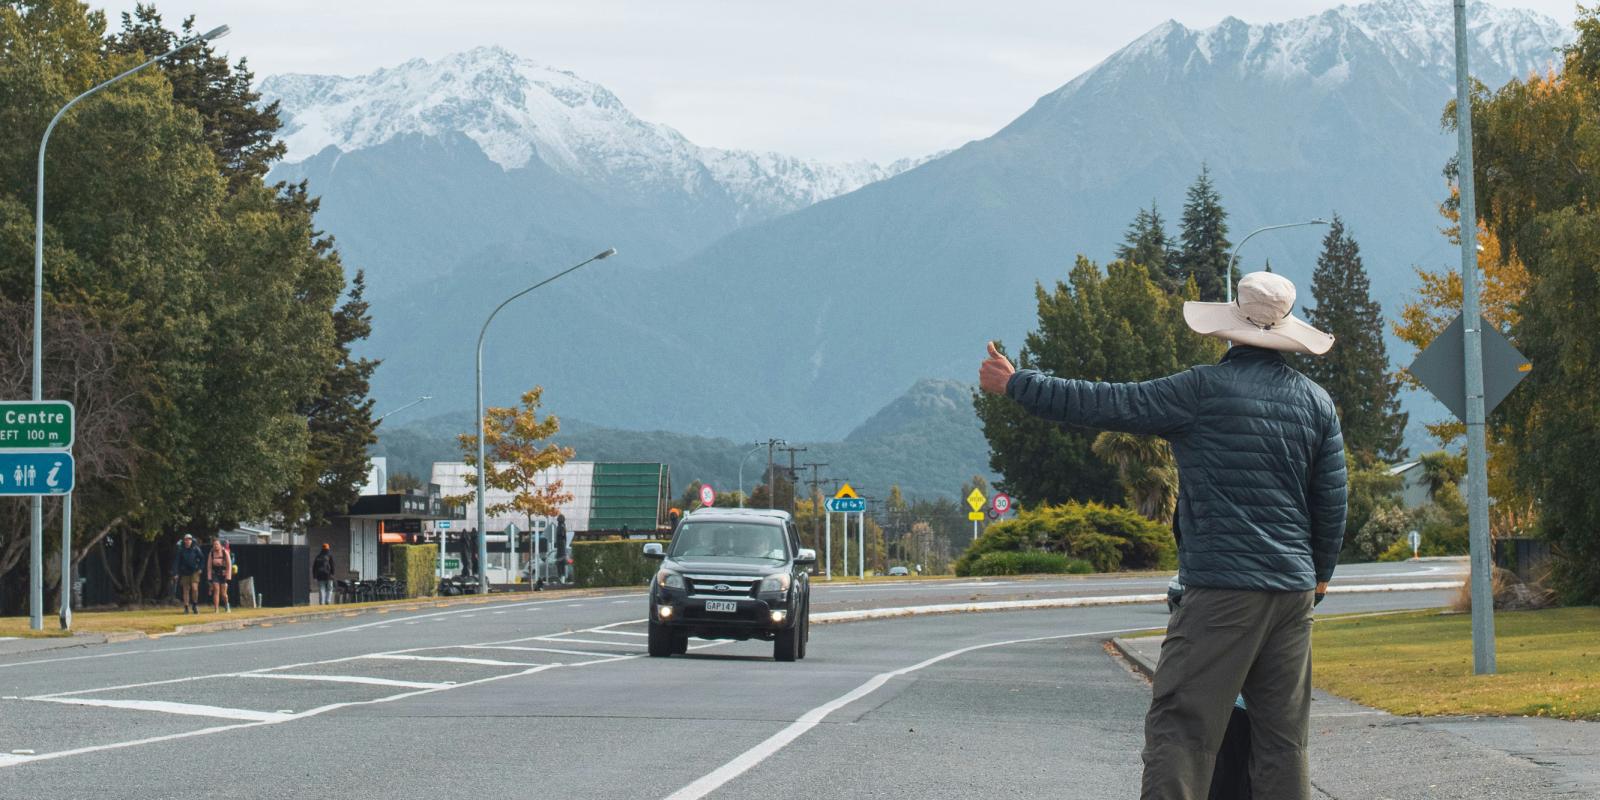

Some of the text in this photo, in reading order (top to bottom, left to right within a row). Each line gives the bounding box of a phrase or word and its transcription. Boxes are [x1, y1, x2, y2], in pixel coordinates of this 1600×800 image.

[6, 411, 64, 424] Centre
[27, 430, 45, 440] 100
[997, 499, 1006, 508] 30
[706, 601, 735, 611] GAP147
